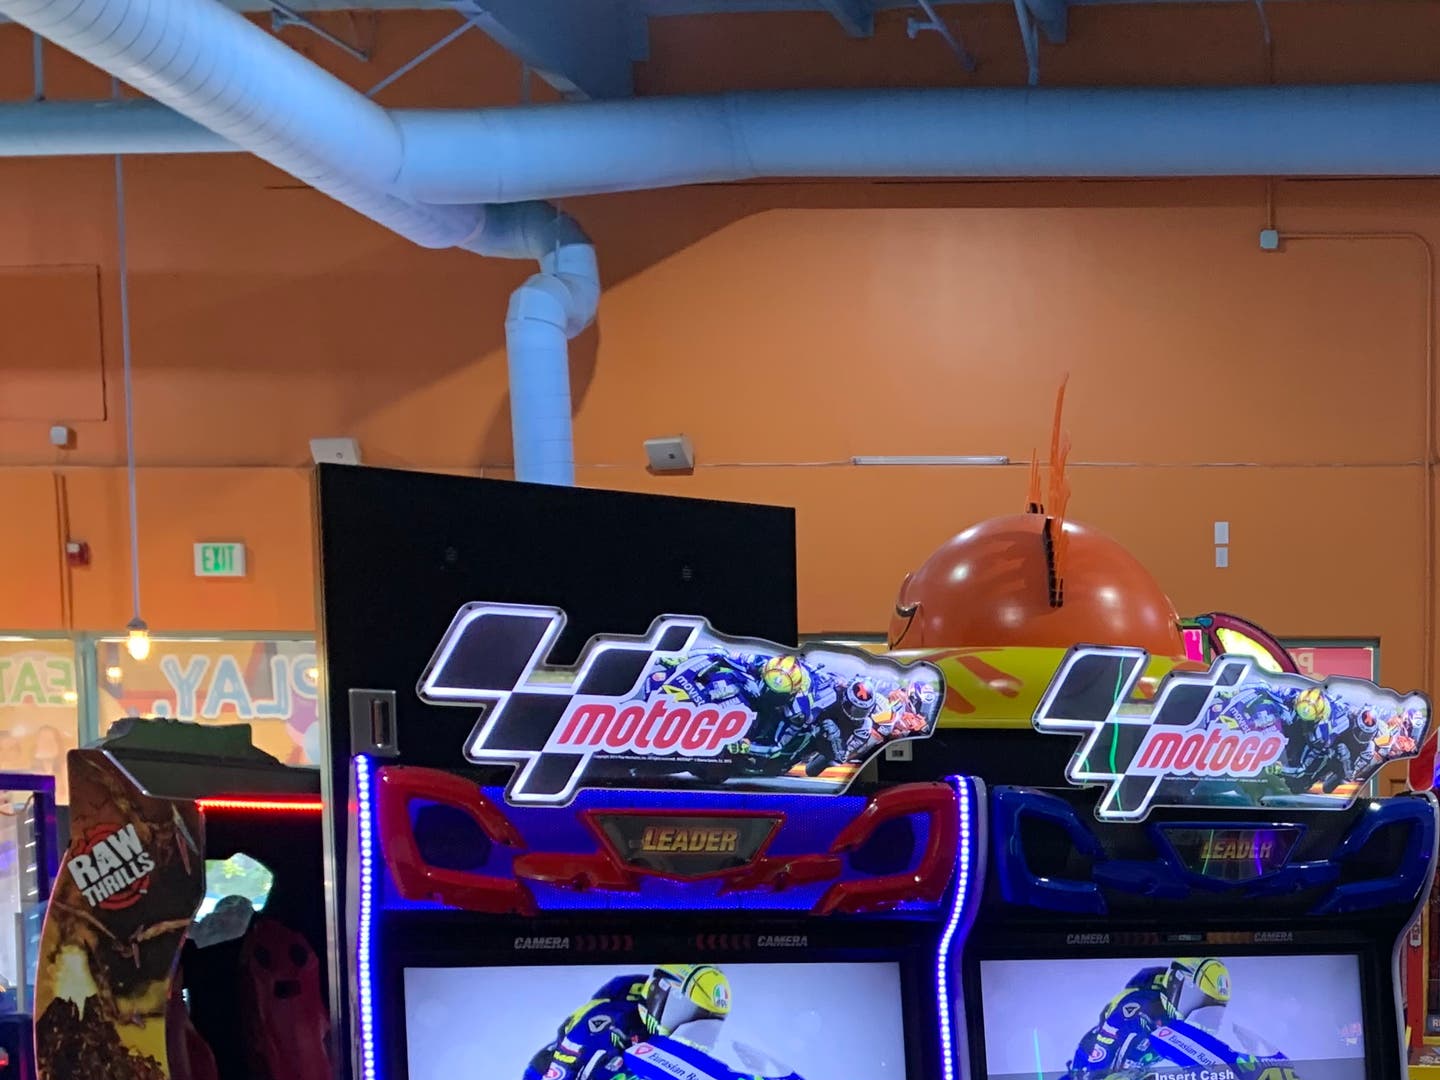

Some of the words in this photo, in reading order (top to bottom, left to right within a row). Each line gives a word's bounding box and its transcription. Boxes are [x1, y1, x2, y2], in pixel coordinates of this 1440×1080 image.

[201, 546, 236, 571] EXIT
[641, 826, 738, 853] LEADER
[1200, 840, 1273, 861] LEADER
[67, 823, 143, 891] RAW
[81, 851, 155, 907] THRILLS
[514, 936, 570, 949] CAMERA
[757, 935, 808, 947] CAMERA
[1066, 933, 1110, 944] CAMERA
[1254, 931, 1293, 942] CAMERA
[1200, 1070, 1234, 1080] Cash
